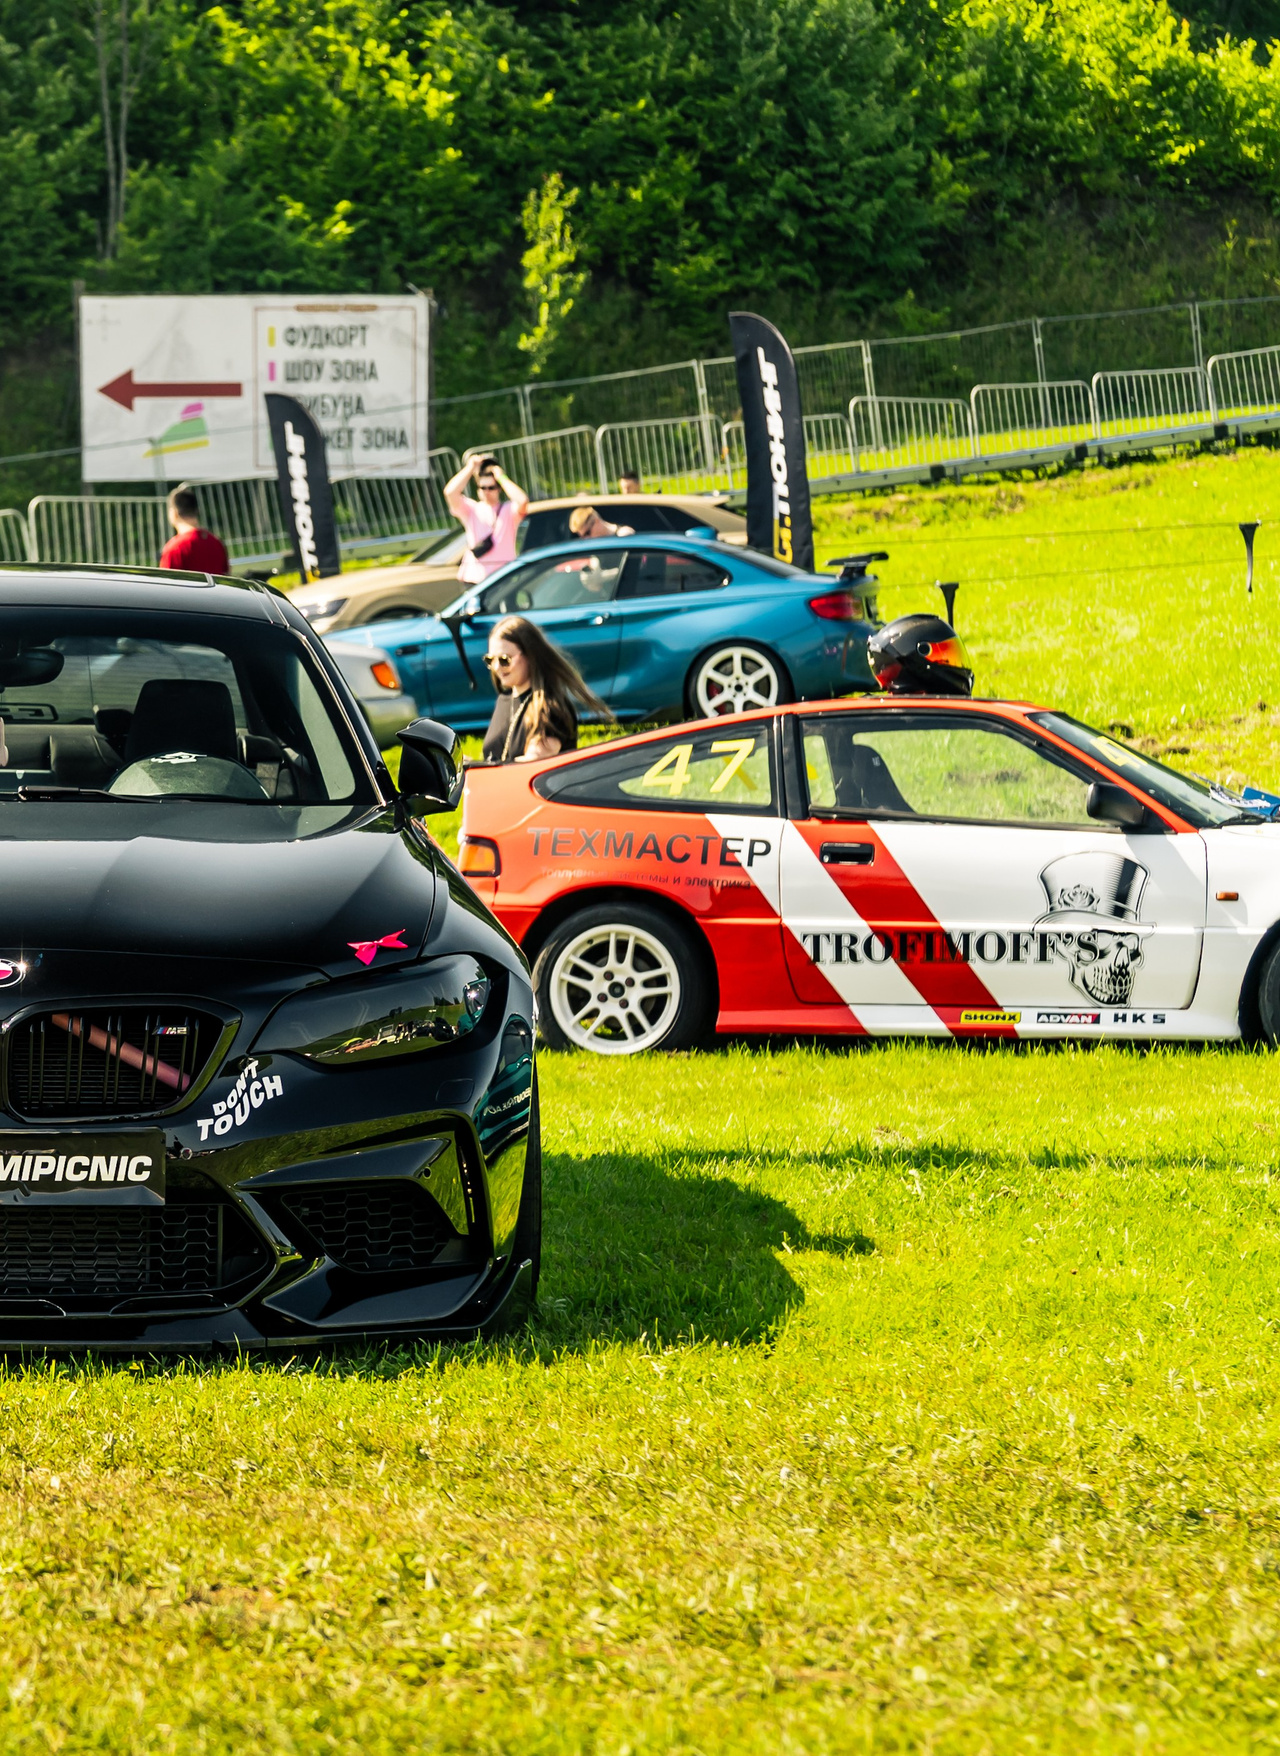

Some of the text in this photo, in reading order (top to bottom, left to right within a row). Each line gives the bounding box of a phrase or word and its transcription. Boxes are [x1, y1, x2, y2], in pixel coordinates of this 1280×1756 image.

[283, 325, 369, 348] ФУДКОРТ
[284, 359, 378, 382] ШОУ ЗОНА
[322, 427, 410, 450] КЕТ ЗОНА
[642, 738, 755, 796] 47
[526, 827, 772, 867] ТЕХМАСТЕР
[673, 876, 682, 885] и
[685, 876, 751, 889] электрика
[802, 929, 1099, 966] TROFIMOFF'S
[1037, 1014, 1093, 1023] ADVAN
[212, 1060, 259, 1116] DON'T
[197, 1075, 283, 1141] TOUCH
